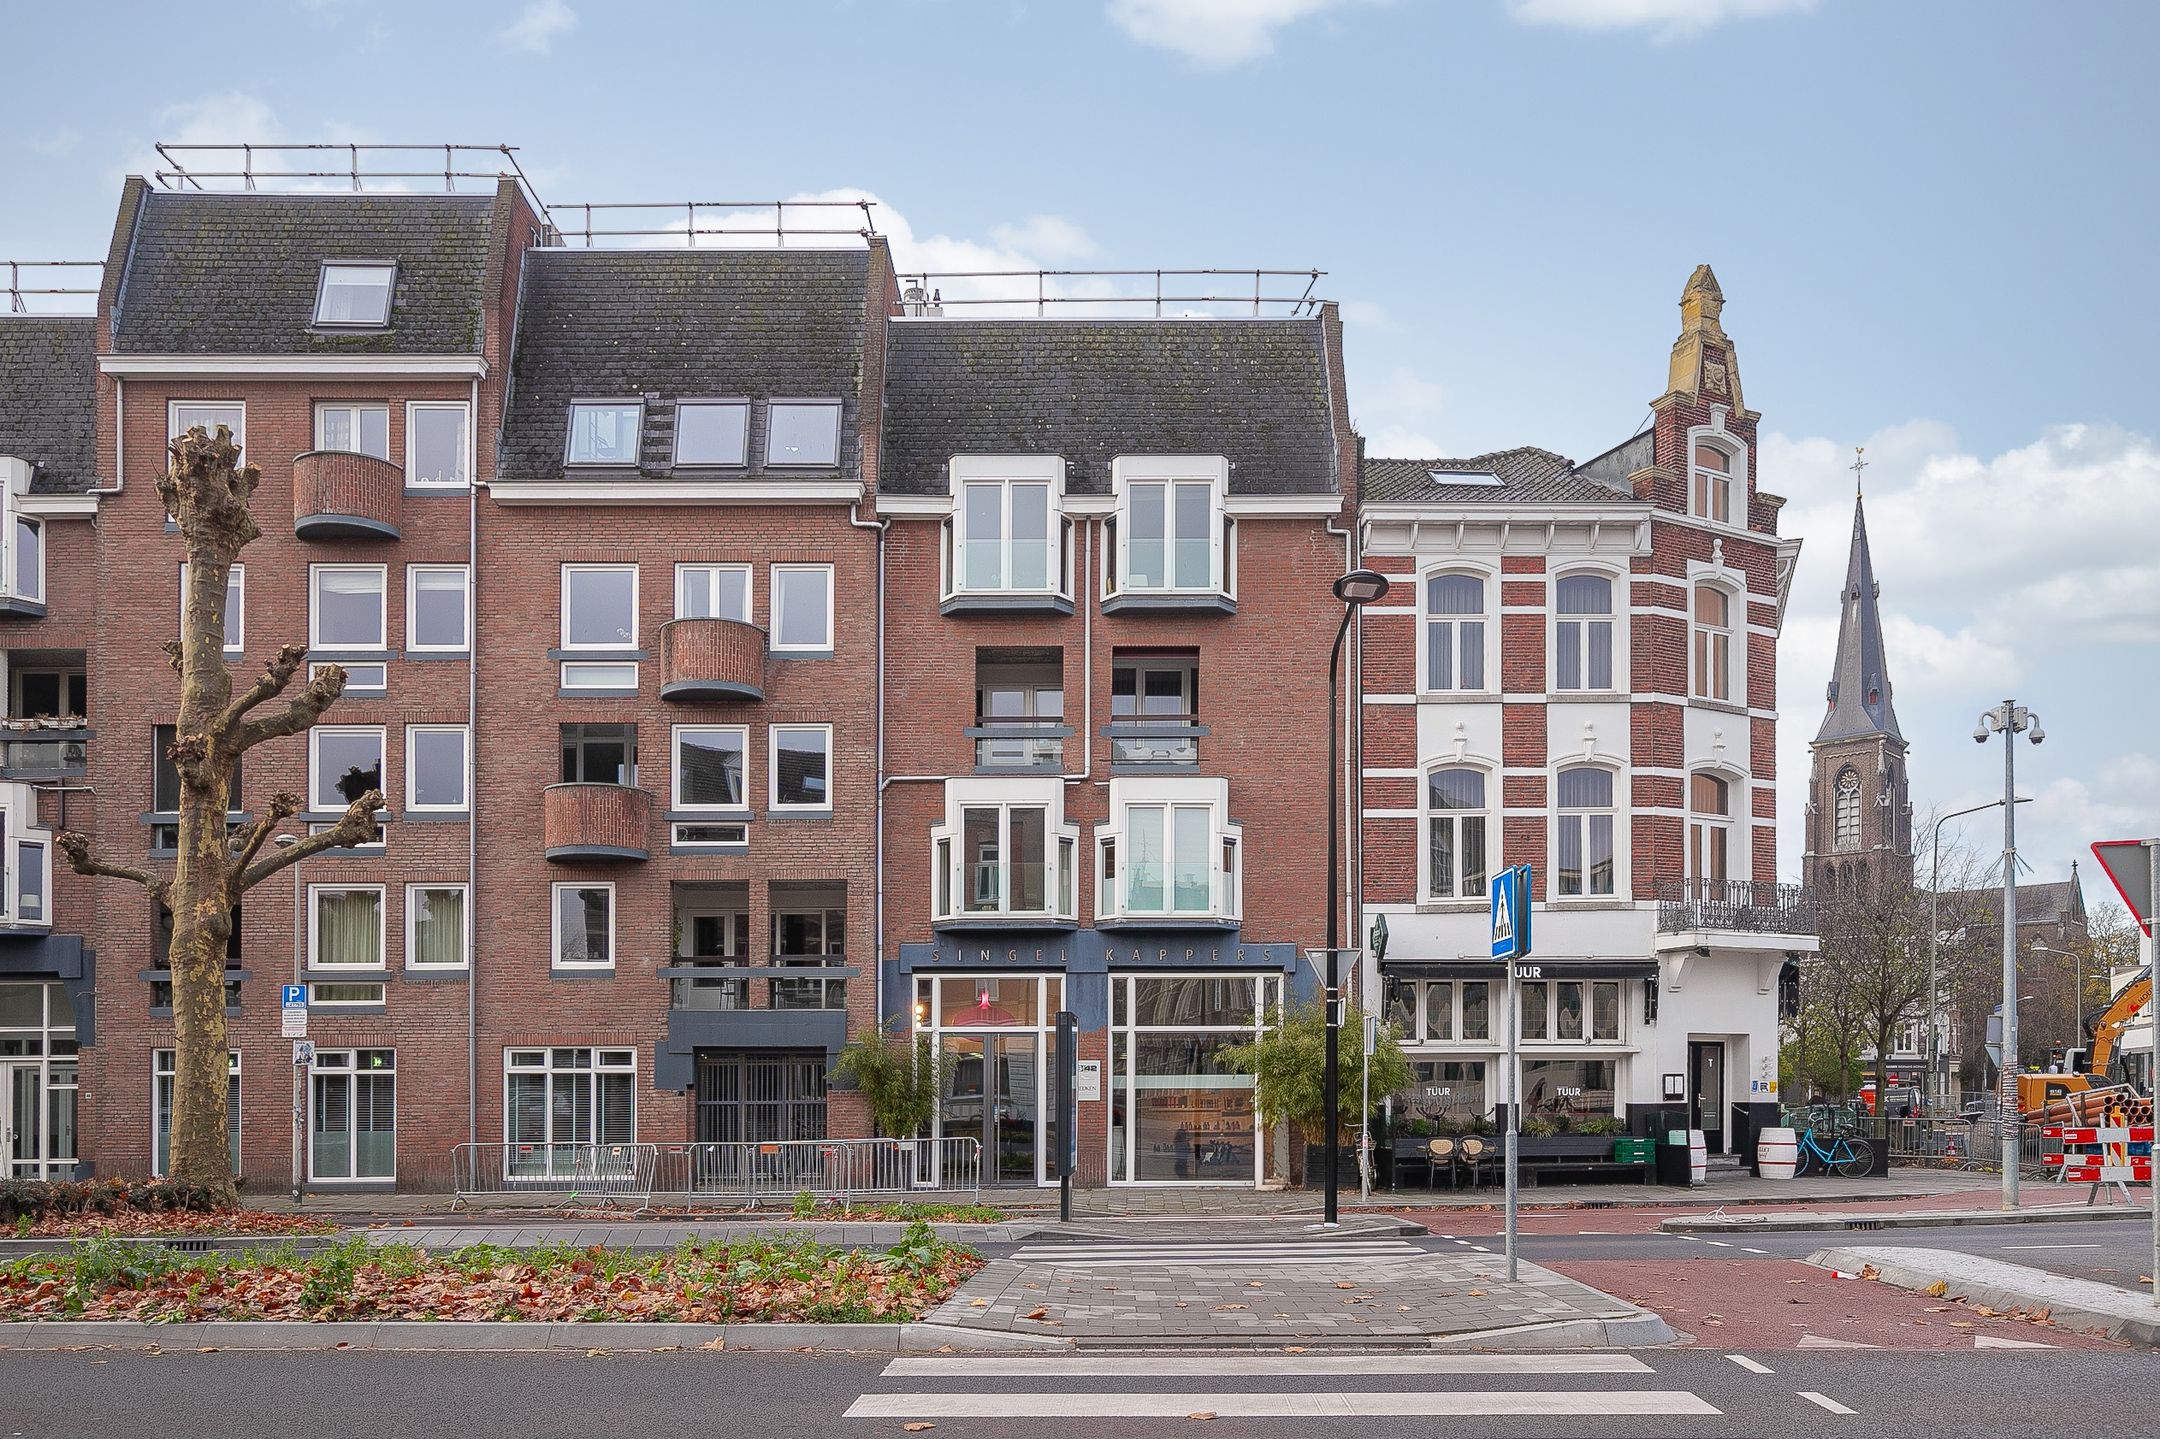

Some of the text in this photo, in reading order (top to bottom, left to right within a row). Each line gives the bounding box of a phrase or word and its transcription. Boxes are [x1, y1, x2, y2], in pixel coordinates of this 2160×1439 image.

[931, 949, 1272, 961] SINGEL KAPPERS
[1505, 966, 1541, 978] UUR
[288, 987, 300, 1002] P
[1426, 1087, 1451, 1096] TUUR
[1556, 1087, 1581, 1096] TUUR
